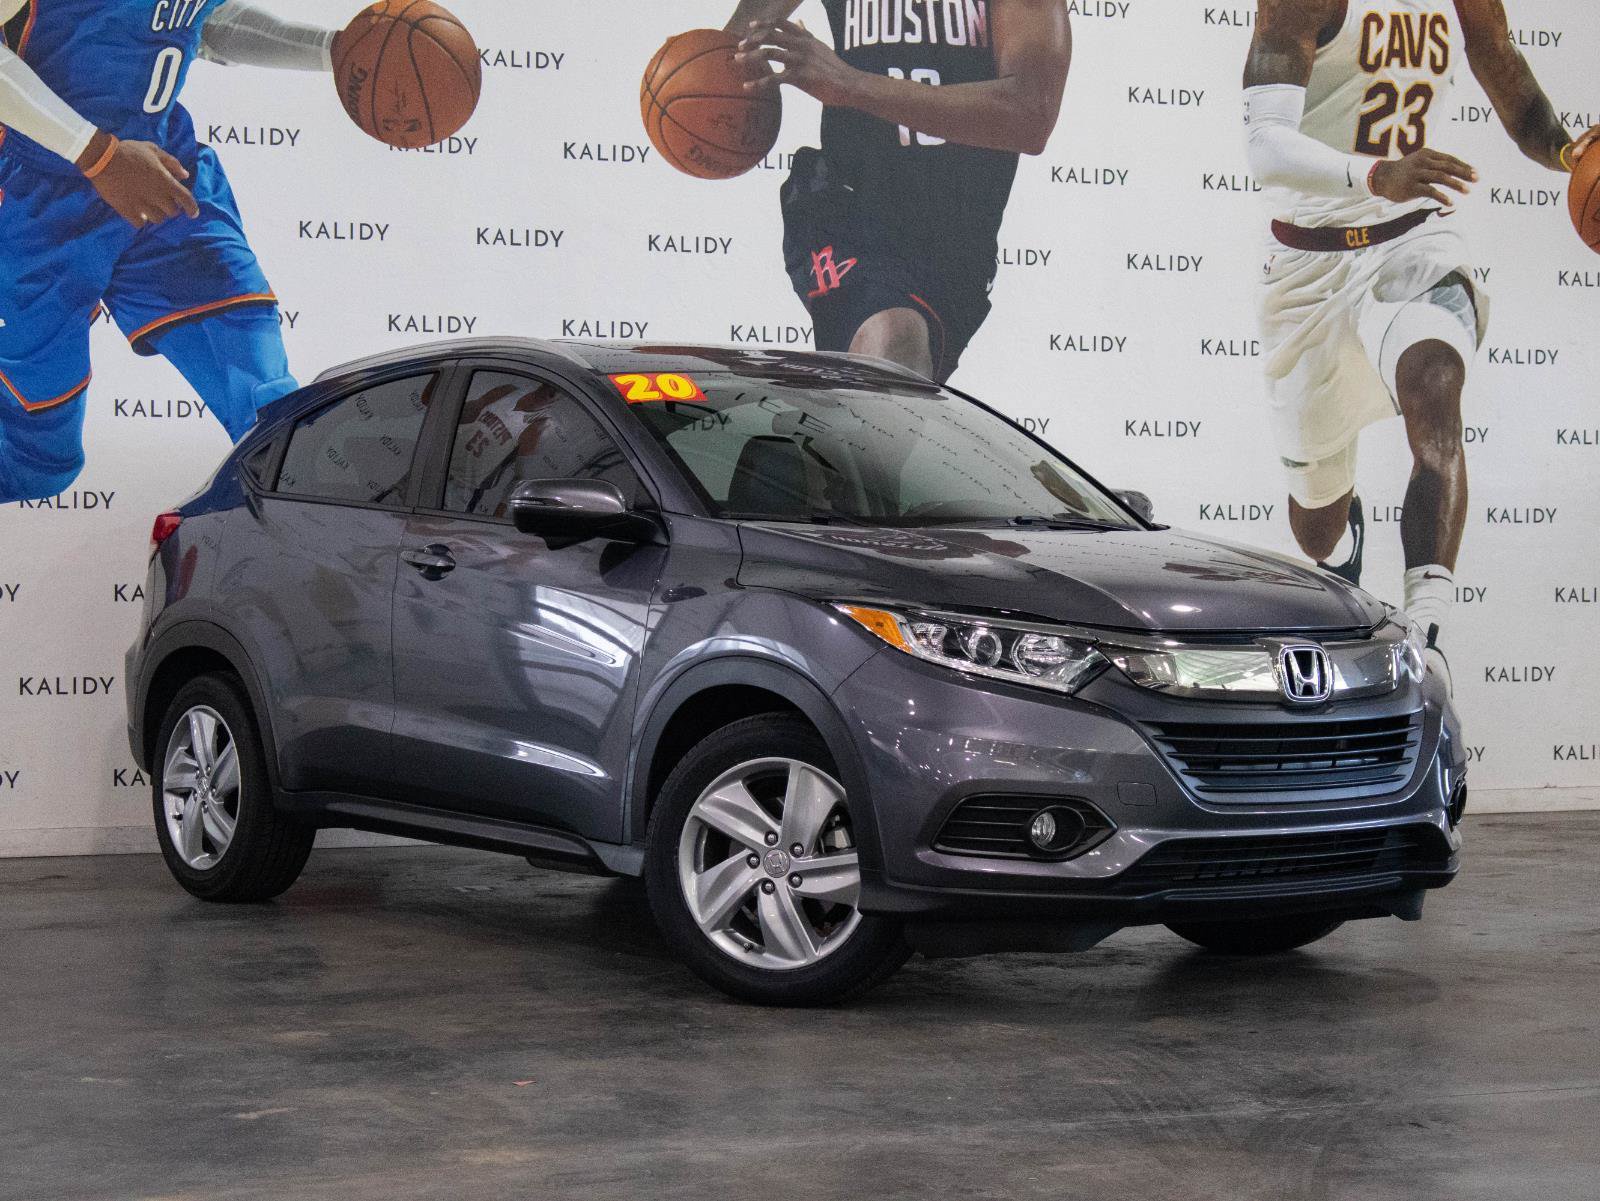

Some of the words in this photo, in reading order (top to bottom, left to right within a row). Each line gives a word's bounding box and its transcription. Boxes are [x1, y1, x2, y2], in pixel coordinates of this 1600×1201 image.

[152, 0, 206, 32] CITY
[1068, 0, 1130, 19] ALIDY
[1205, 8, 1257, 26] KALI
[844, 0, 989, 50] HOUSTON
[1358, 11, 1449, 75] CAVS
[1508, 29, 1562, 47] ALIDY
[478, 49, 565, 71] KALIDY
[143, 47, 182, 113] 0
[1129, 87, 1204, 106] KALIDY
[1354, 80, 1434, 157] 23
[1452, 106, 1492, 122] IDY
[208, 125, 301, 147] KALIDY
[563, 143, 650, 164] KALIDY
[1052, 166, 1128, 185] KALIDY
[1204, 174, 1261, 191] KALI
[1491, 188, 1560, 206] KALIDY
[300, 221, 389, 240] KALIDY
[477, 228, 564, 247] KALIDY
[1345, 228, 1371, 248] CLE
[649, 235, 732, 254] KALIDY
[995, 249, 1051, 266] LIDY
[1128, 254, 1202, 271] KALIDY
[1559, 271, 1600, 287] KALI
[389, 314, 476, 333] KALIDY
[563, 320, 648, 338] KALIDY
[731, 325, 813, 343] KALIDY
[1050, 335, 1126, 352] KALIDY
[1202, 339, 1259, 356] KALID
[1489, 348, 1558, 364] KALIDY
[615, 372, 697, 401] 20
[115, 399, 207, 419] KALIDY
[1126, 420, 1201, 437] KALIDY
[1557, 428, 1600, 445] KALI
[1200, 504, 1273, 520] KALIDY
[1374, 507, 1402, 524] LID
[1488, 508, 1556, 523] KALIDY
[1456, 587, 1486, 602] IDY
[1555, 587, 1597, 602] KALI
[1486, 666, 1555, 682] KALIDY
[20, 677, 114, 695] KALIDY
[1554, 745, 1597, 760] KALI
